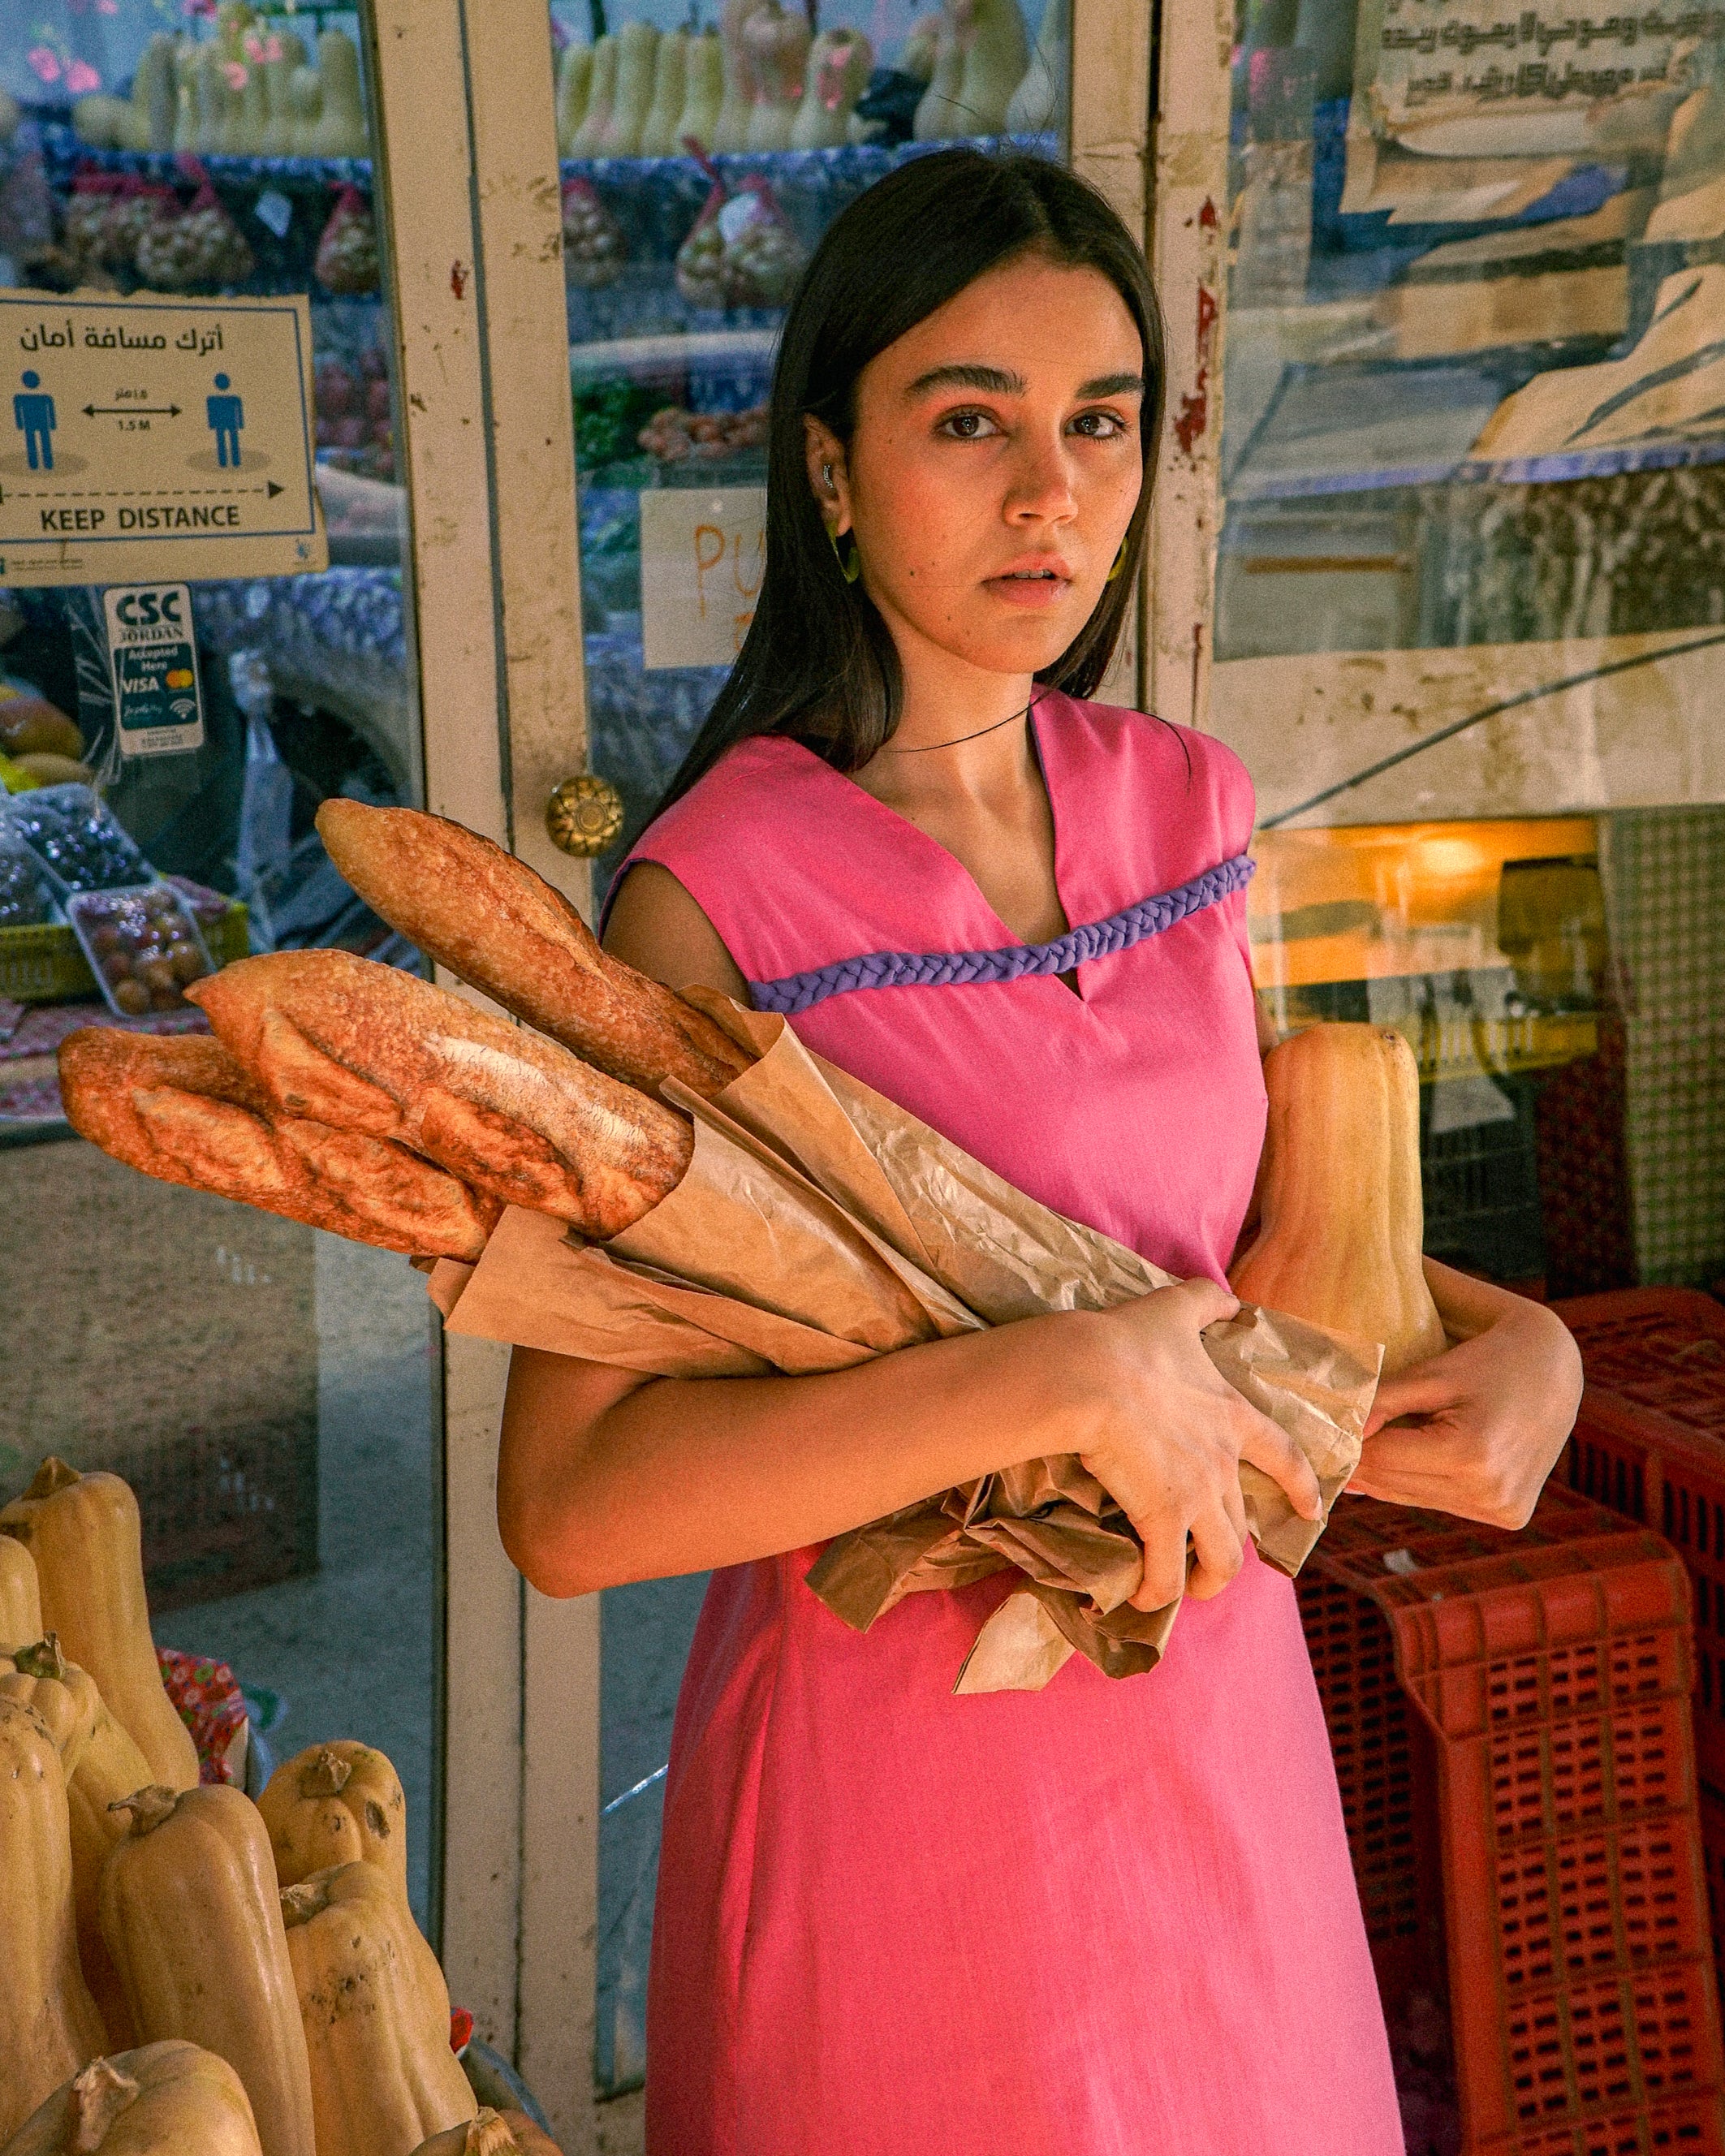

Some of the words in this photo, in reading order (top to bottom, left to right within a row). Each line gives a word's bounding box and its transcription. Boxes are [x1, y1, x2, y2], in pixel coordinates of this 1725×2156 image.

[20, 318, 74, 351] أمان
[84, 326, 166, 349] مسافة
[175, 323, 223, 356] أترك
[118, 419, 136, 431] 1.5
[139, 419, 151, 431] M
[41, 508, 105, 530] KEEP
[118, 506, 240, 528] DISTANCE
[116, 591, 182, 626] CSC
[120, 626, 184, 643] JORDAN
[128, 647, 179, 660] Accepted
[141, 661, 168, 672] Here
[121, 676, 161, 694] VISA
